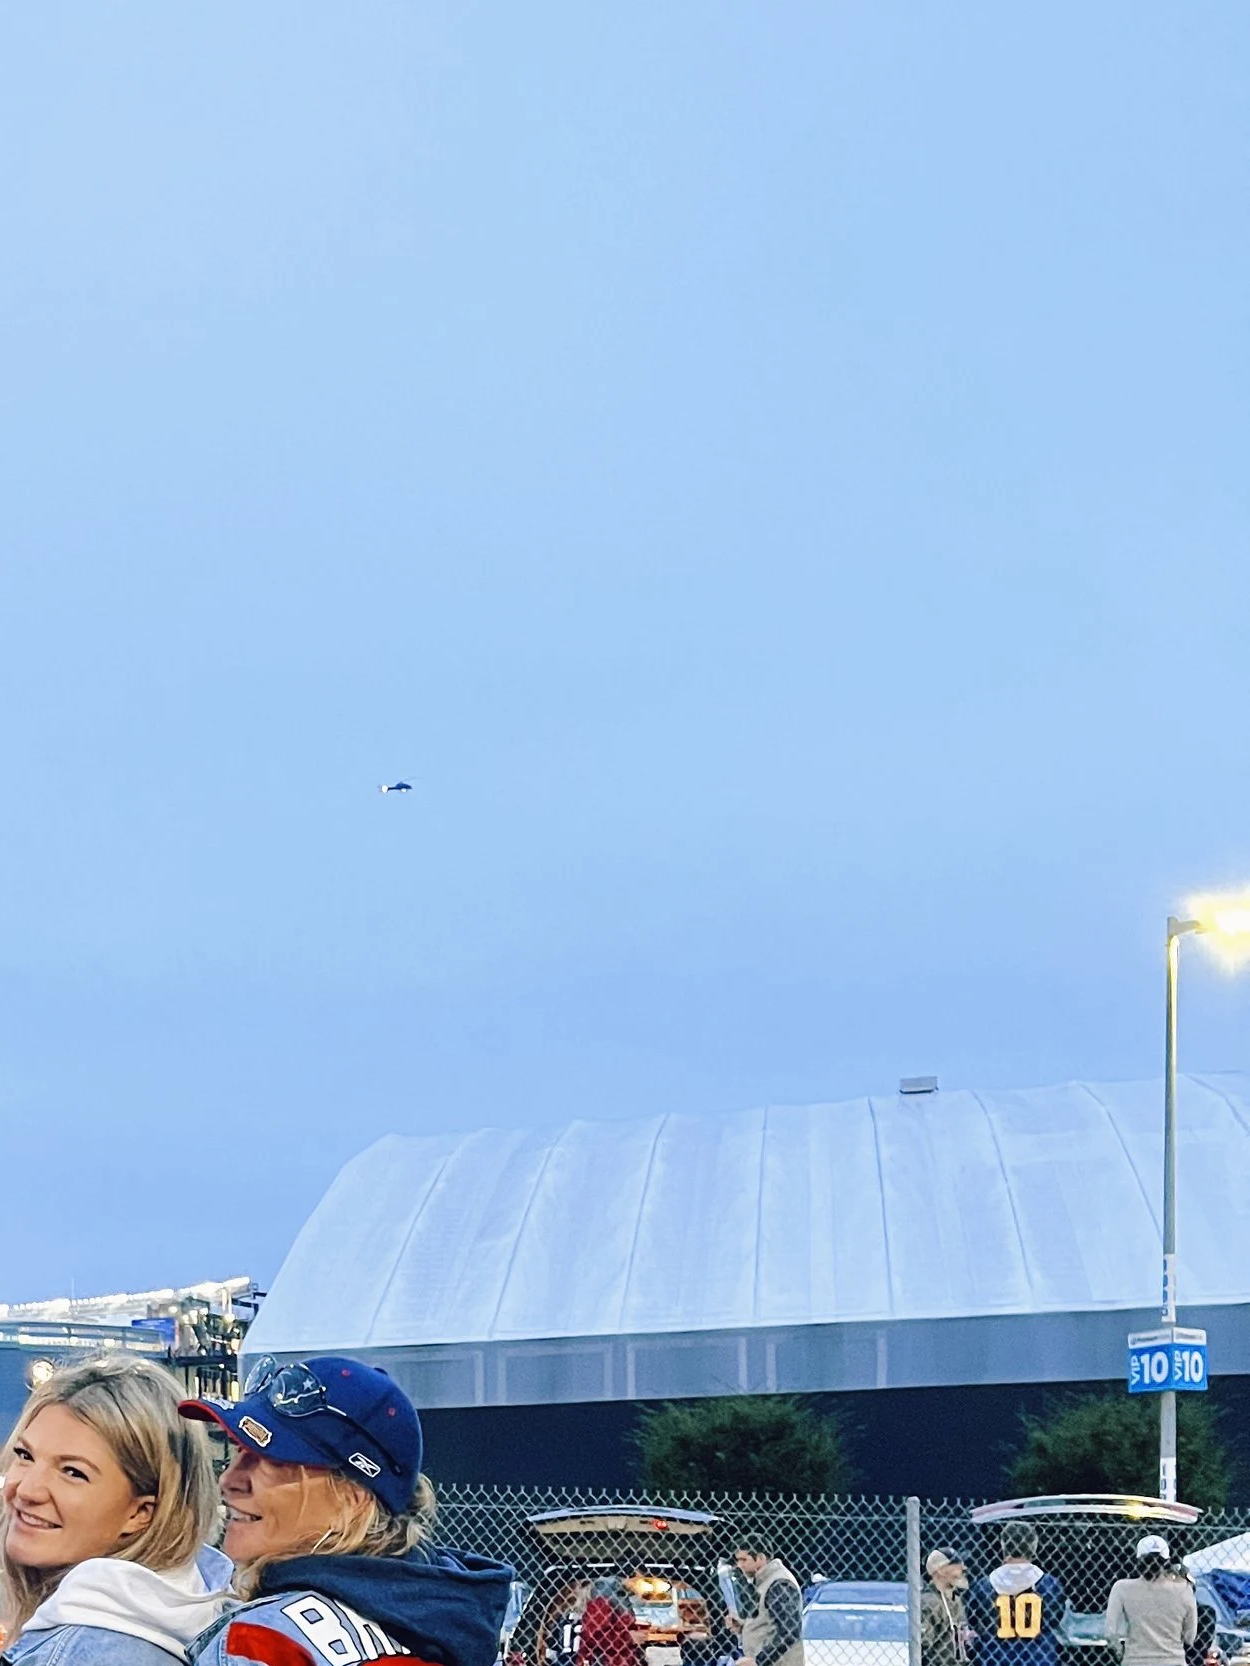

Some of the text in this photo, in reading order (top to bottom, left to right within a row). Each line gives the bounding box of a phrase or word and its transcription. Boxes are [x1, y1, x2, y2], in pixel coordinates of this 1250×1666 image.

[1130, 1351, 1169, 1386] VIP 10
[1174, 1350, 1204, 1383] VIP 10
[996, 1592, 1043, 1638] 10
